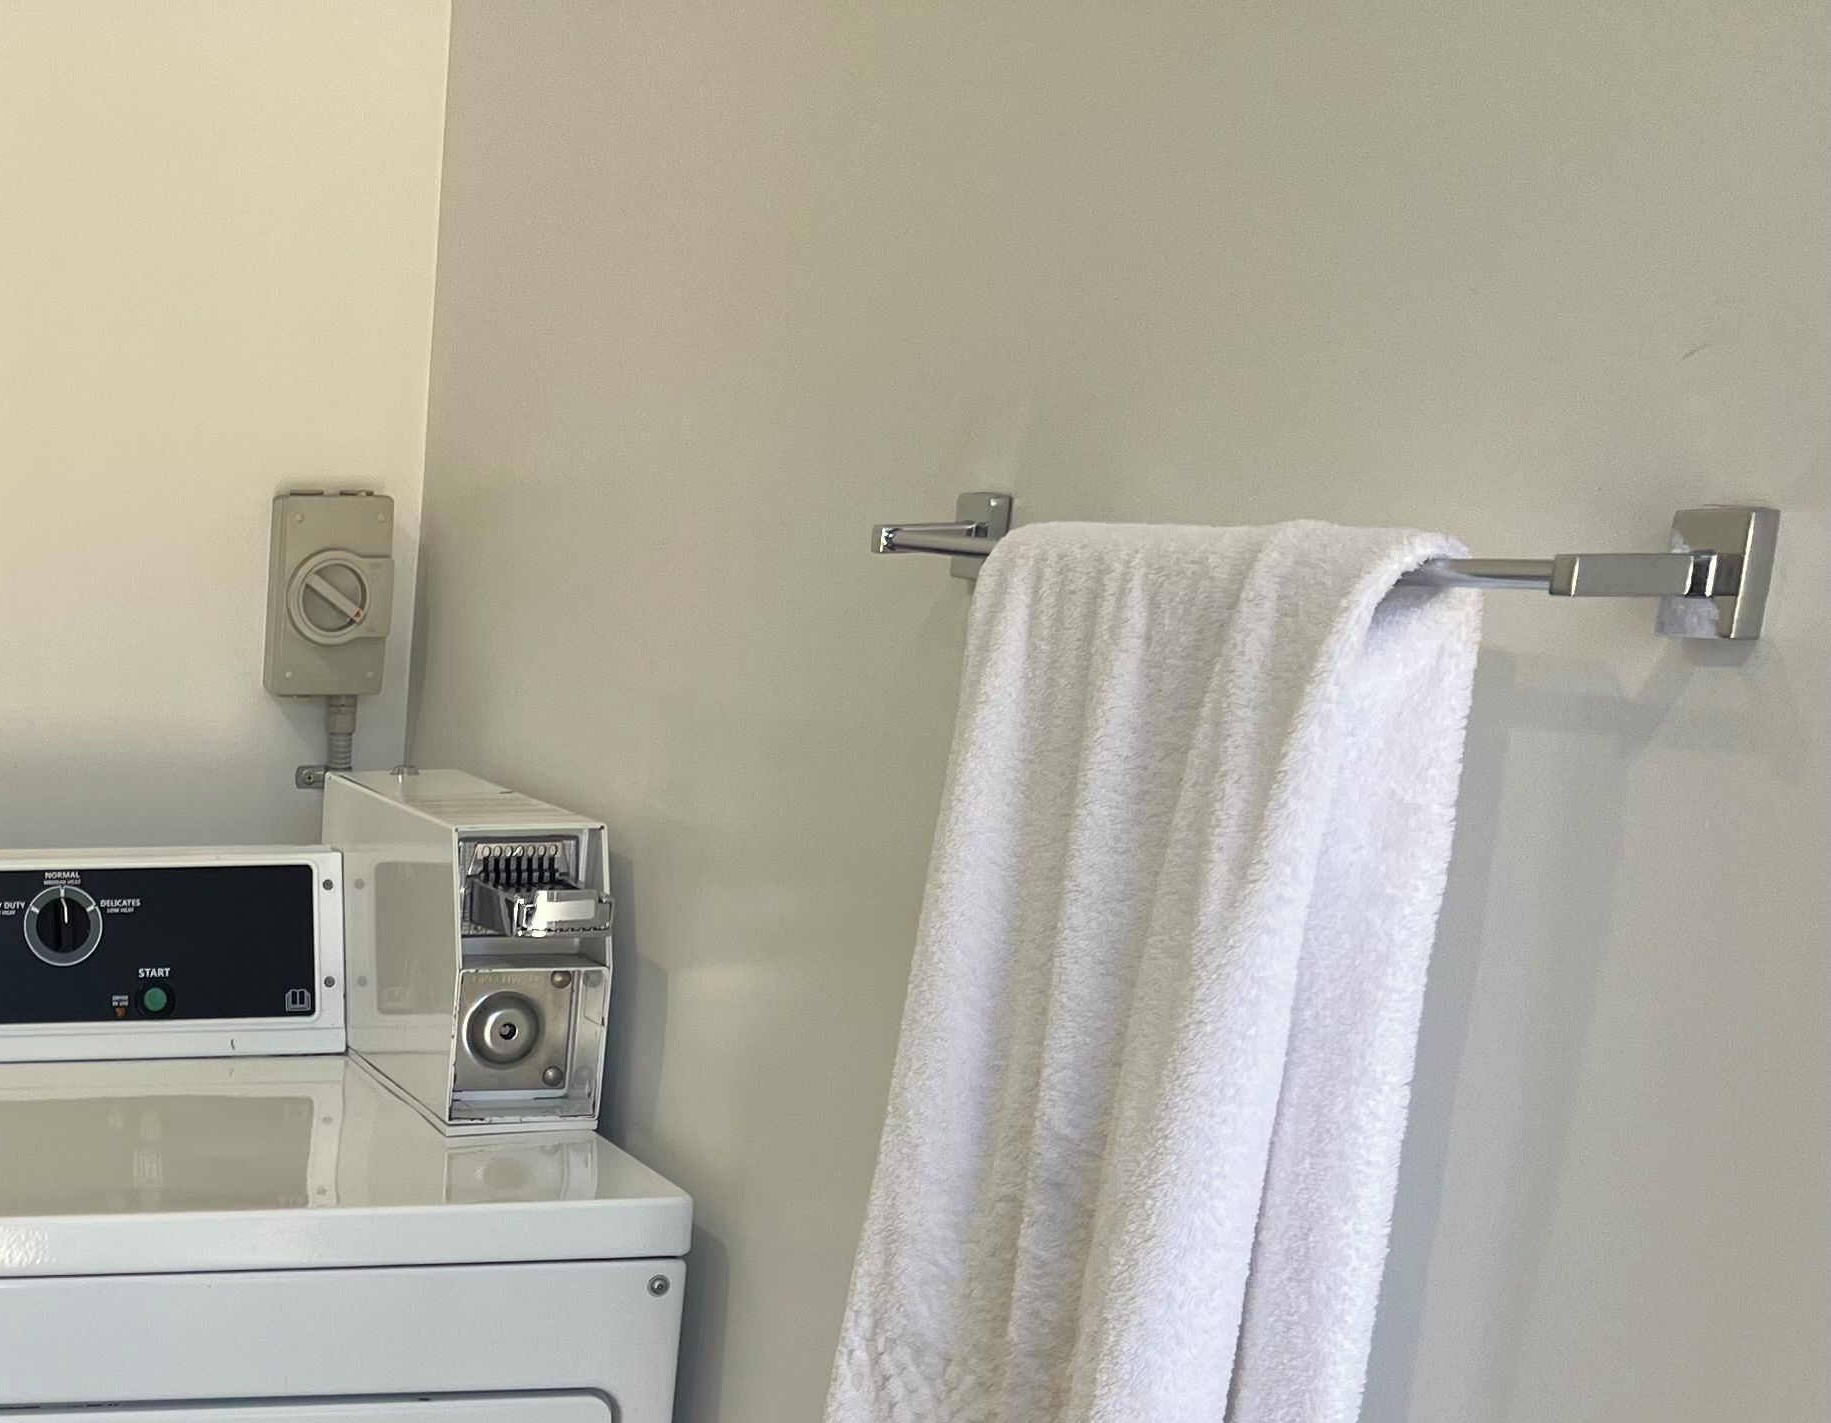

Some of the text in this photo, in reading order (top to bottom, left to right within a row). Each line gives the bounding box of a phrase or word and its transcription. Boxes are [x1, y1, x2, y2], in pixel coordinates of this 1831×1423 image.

[44, 871, 80, 879] NORMAL
[3, 901, 26, 910] DUTY
[100, 899, 141, 908] DELICATES
[138, 967, 171, 978] START
